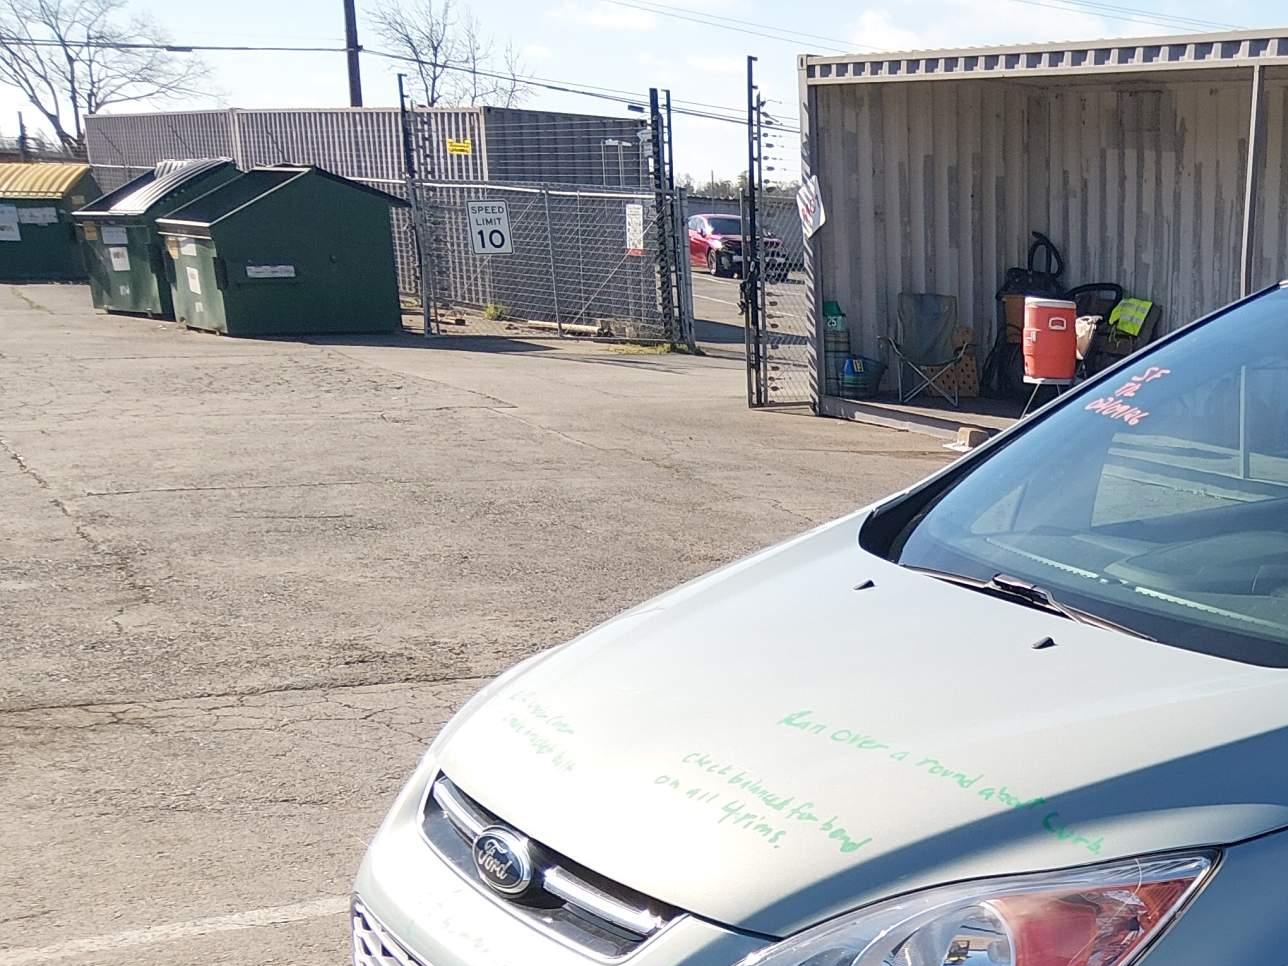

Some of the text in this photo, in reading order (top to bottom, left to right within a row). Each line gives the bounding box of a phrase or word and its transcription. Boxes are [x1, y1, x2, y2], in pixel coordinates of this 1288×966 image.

[471, 206, 505, 215] SPEED
[475, 217, 502, 226] LIMIT
[477, 229, 506, 249] 10
[477, 838, 514, 881] Ford
